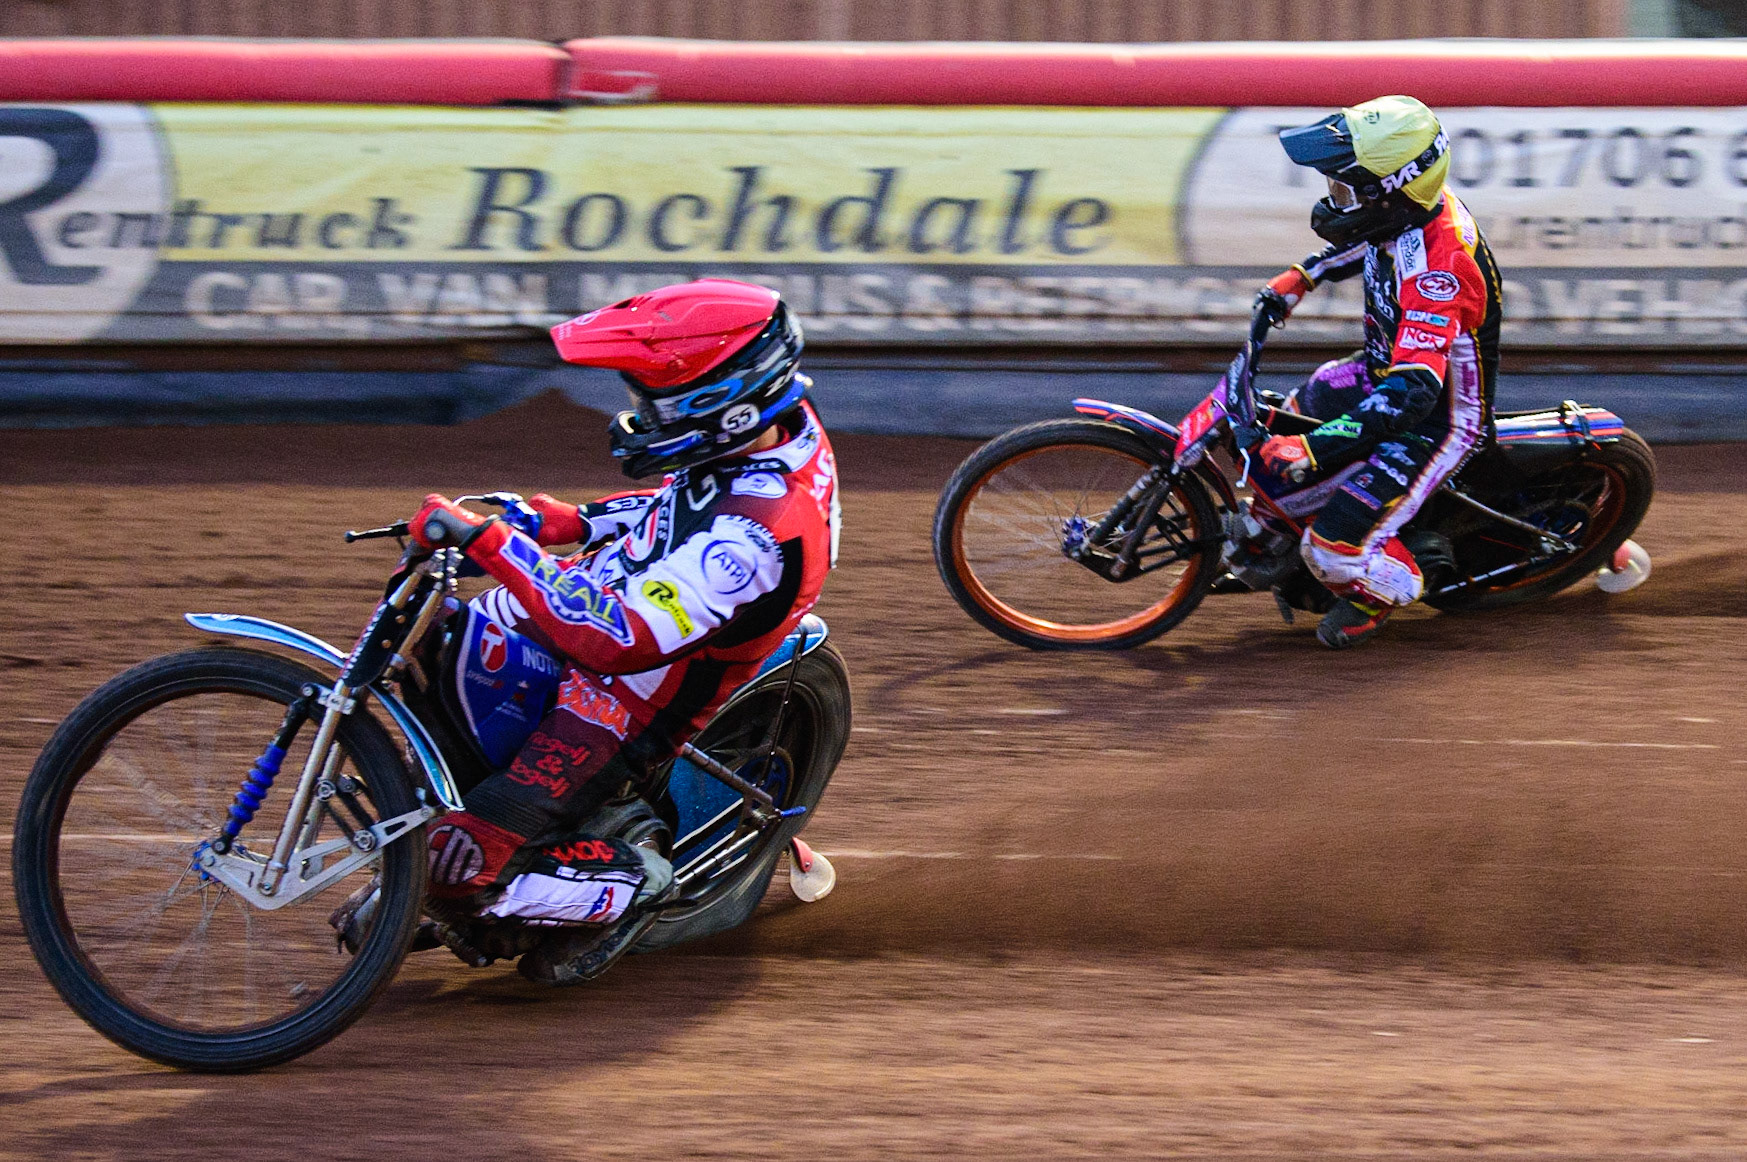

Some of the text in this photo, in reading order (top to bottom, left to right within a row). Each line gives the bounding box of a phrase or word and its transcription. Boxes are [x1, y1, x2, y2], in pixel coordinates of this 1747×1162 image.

[450, 164, 1114, 256] Rochdale
[184, 271, 372, 330] CAR
[376, 273, 550, 325] VAN
[532, 557, 616, 624] REALL
